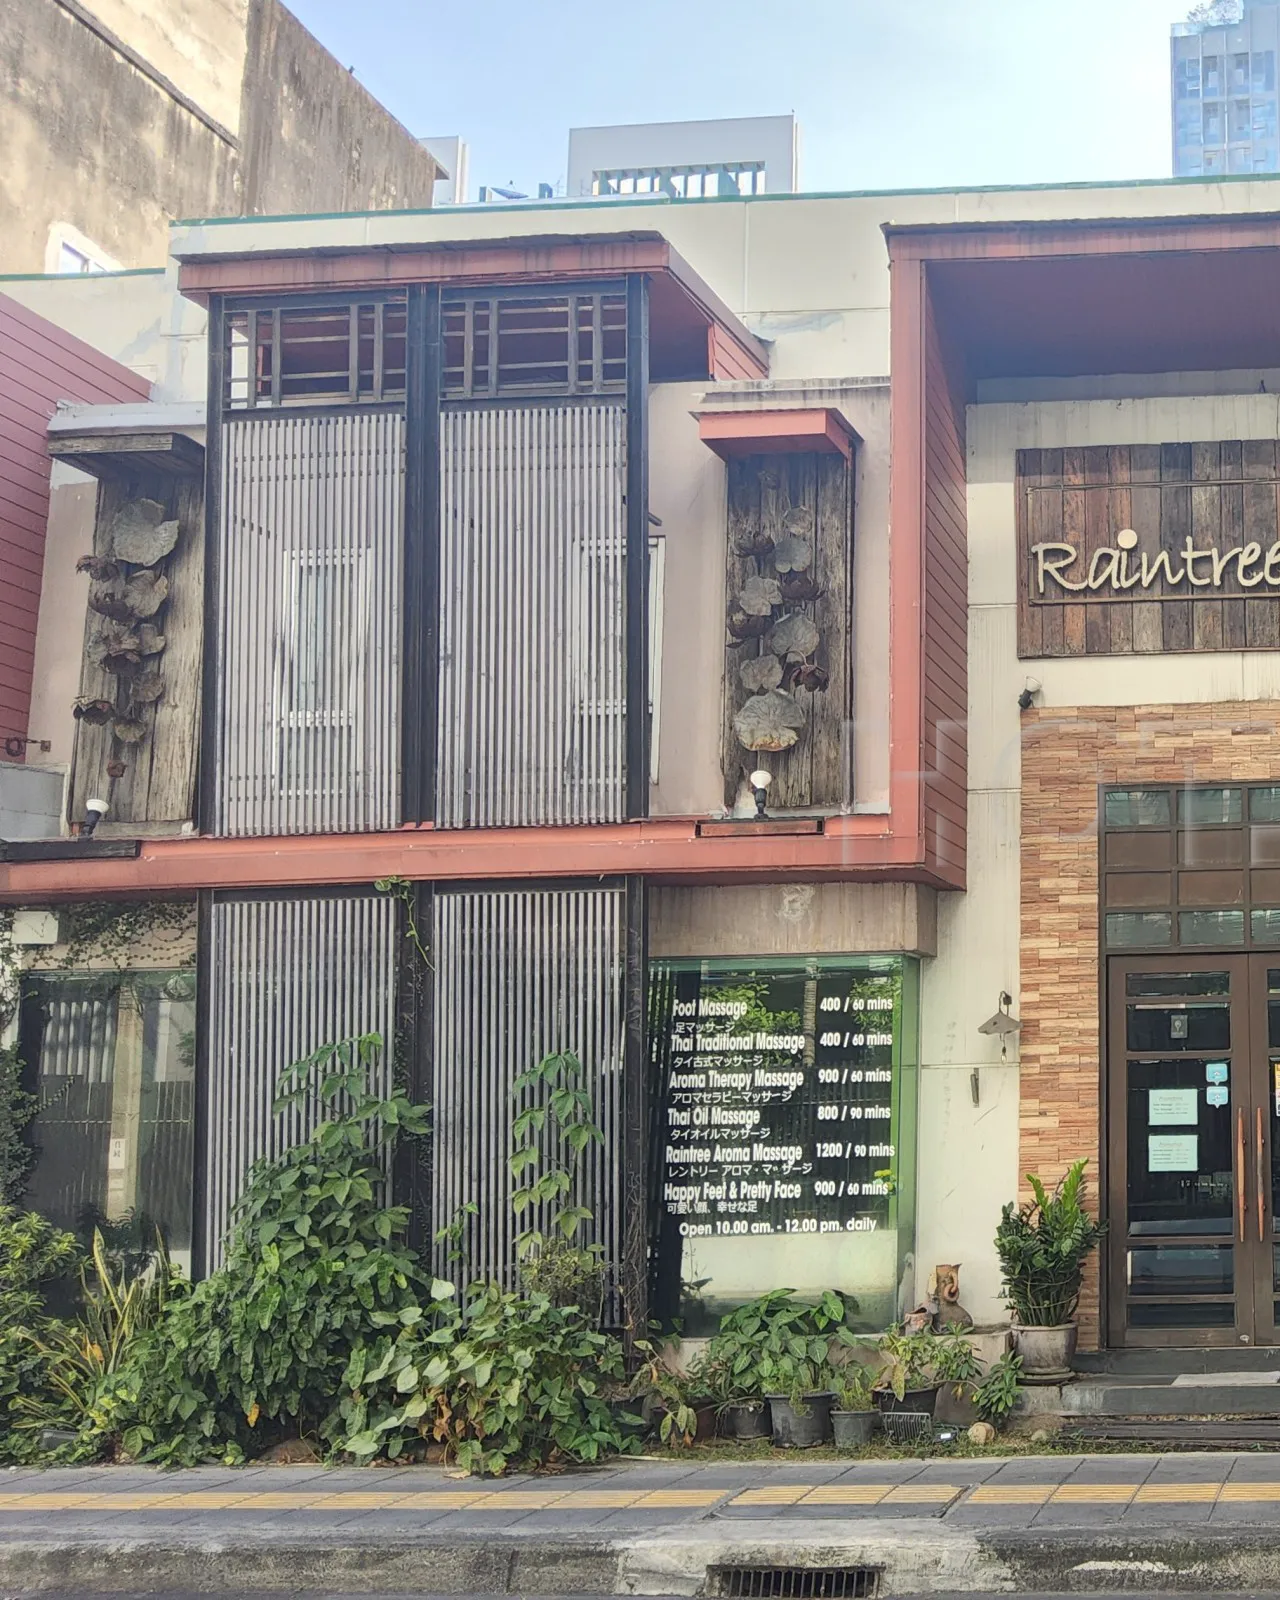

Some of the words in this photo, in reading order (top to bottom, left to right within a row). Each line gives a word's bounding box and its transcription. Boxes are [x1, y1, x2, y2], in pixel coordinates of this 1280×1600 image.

[673, 999, 696, 1016] Foot
[699, 999, 748, 1020] Massage
[820, 997, 841, 1011] 400
[843, 997, 850, 1012] /
[852, 999, 864, 1010] 60
[867, 997, 893, 1010] mins
[675, 1021, 735, 1033] 足マッサージ
[671, 1034, 694, 1052] Thai
[696, 1032, 753, 1051] Traditional
[756, 1032, 805, 1054] Massage
[820, 1032, 841, 1046] 400
[843, 1032, 850, 1047] /
[852, 1034, 864, 1046] 60
[867, 1032, 892, 1046] mins
[673, 1054, 763, 1068] タイ古式マッサージ
[669, 1071, 706, 1089] Aroma
[708, 1069, 752, 1091] Therapy
[755, 1069, 804, 1091] Massage
[818, 1069, 839, 1083] 900
[842, 1069, 848, 1084] /
[851, 1071, 863, 1082] 60
[865, 1068, 892, 1082] mins
[668, 1108, 691, 1125] Thai
[692, 1106, 709, 1125] Oil
[711, 1107, 760, 1129] Massage
[817, 1106, 838, 1120] 800
[841, 1106, 847, 1121] /
[850, 1107, 862, 1119] 90
[864, 1105, 891, 1119] mins
[670, 1127, 771, 1140] タイオイルマッサージ
[665, 1145, 711, 1163] Raintree
[713, 1144, 750, 1162] Aroma
[752, 1143, 803, 1166] Massage
[816, 1143, 843, 1158] 1200
[845, 1143, 852, 1159] /
[854, 1145, 867, 1157] 90
[869, 1142, 895, 1157] mins
[669, 1165, 718, 1177] レントリー
[664, 1183, 701, 1204] Happy
[703, 1181, 727, 1200] Feet
[729, 1181, 738, 1199] &
[740, 1180, 772, 1202] Pretty
[774, 1180, 802, 1199] Face
[814, 1181, 835, 1196] 900
[838, 1181, 845, 1197] /
[847, 1183, 859, 1195] 60
[862, 1181, 888, 1195] mins
[679, 1222, 712, 1237] Open
[716, 1220, 748, 1234] 10.00
[751, 1222, 774, 1234] am.
[785, 1219, 817, 1233] 12.00
[820, 1220, 843, 1234] pm.
[846, 1217, 877, 1232] daily
